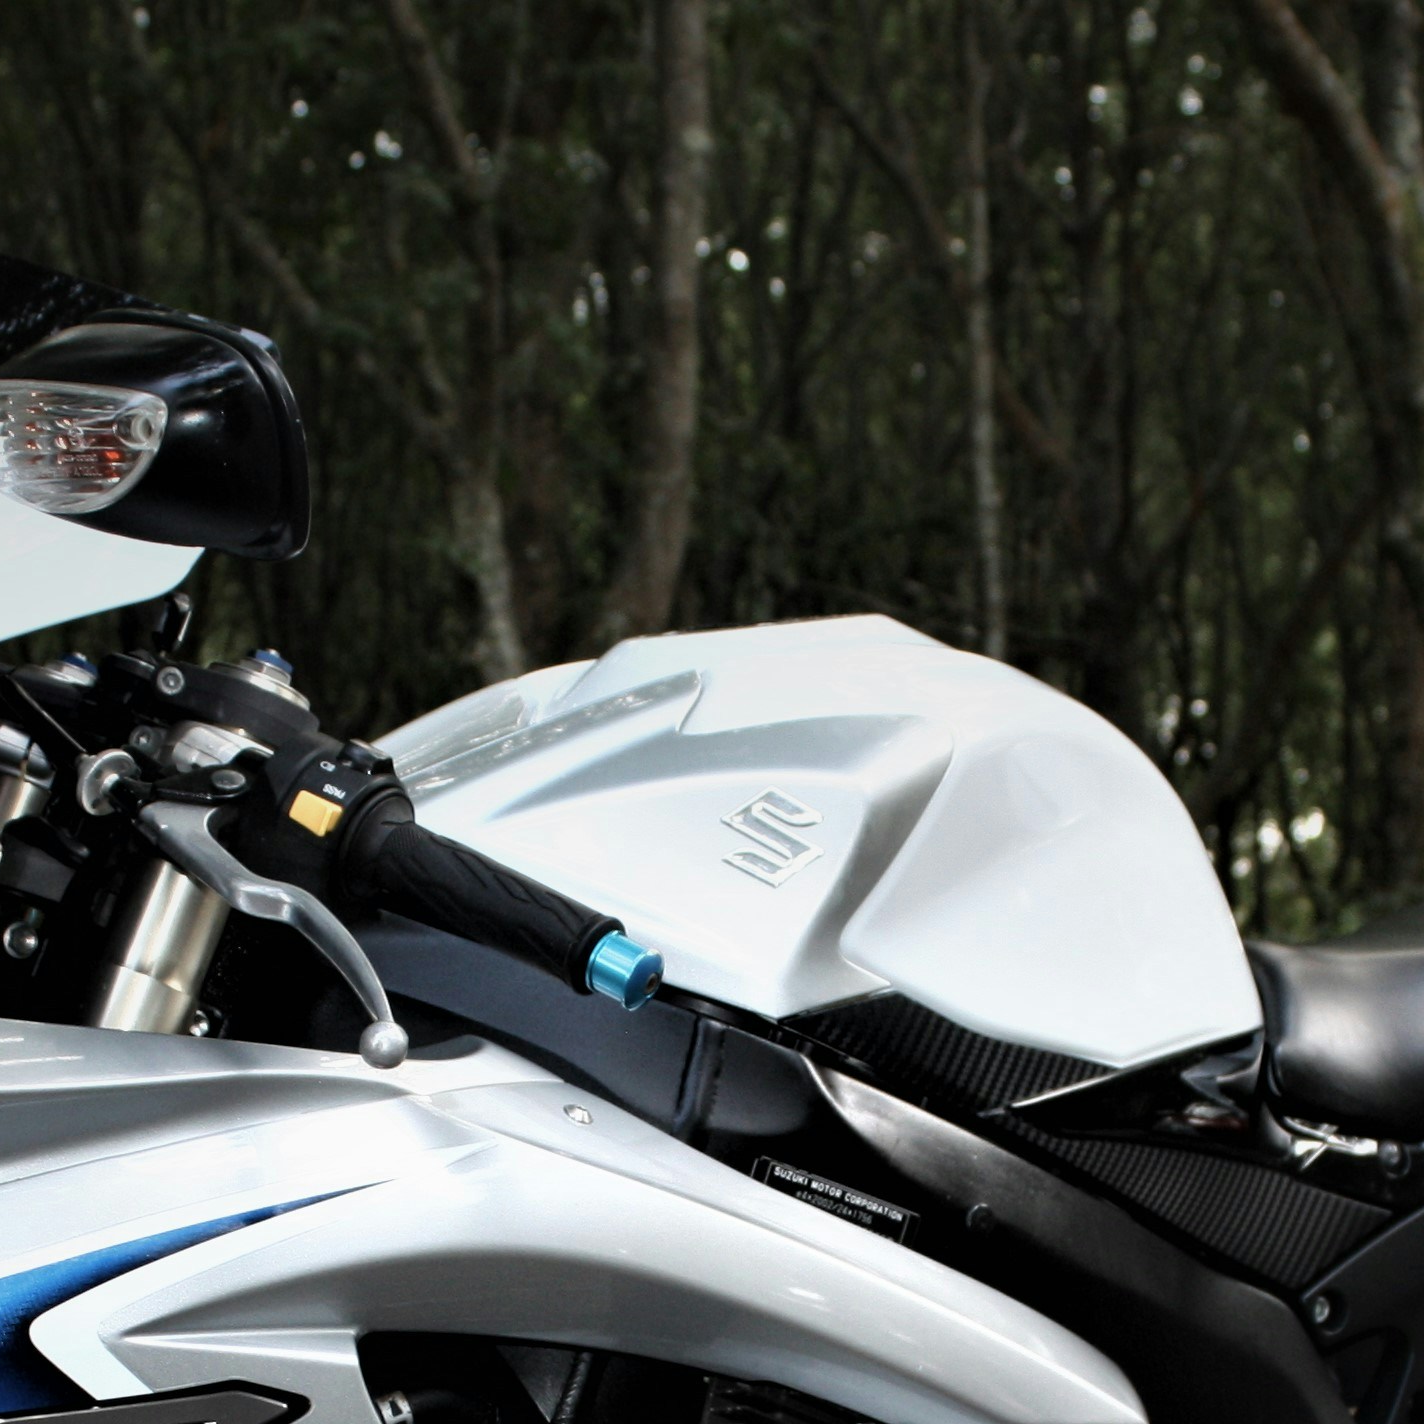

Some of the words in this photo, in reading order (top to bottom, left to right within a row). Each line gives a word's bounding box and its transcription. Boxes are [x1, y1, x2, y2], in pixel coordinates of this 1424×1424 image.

[773, 1166, 808, 1186] SUZUKI
[811, 1180, 843, 1198] MOTOR
[844, 1192, 903, 1222] CORPORATION
